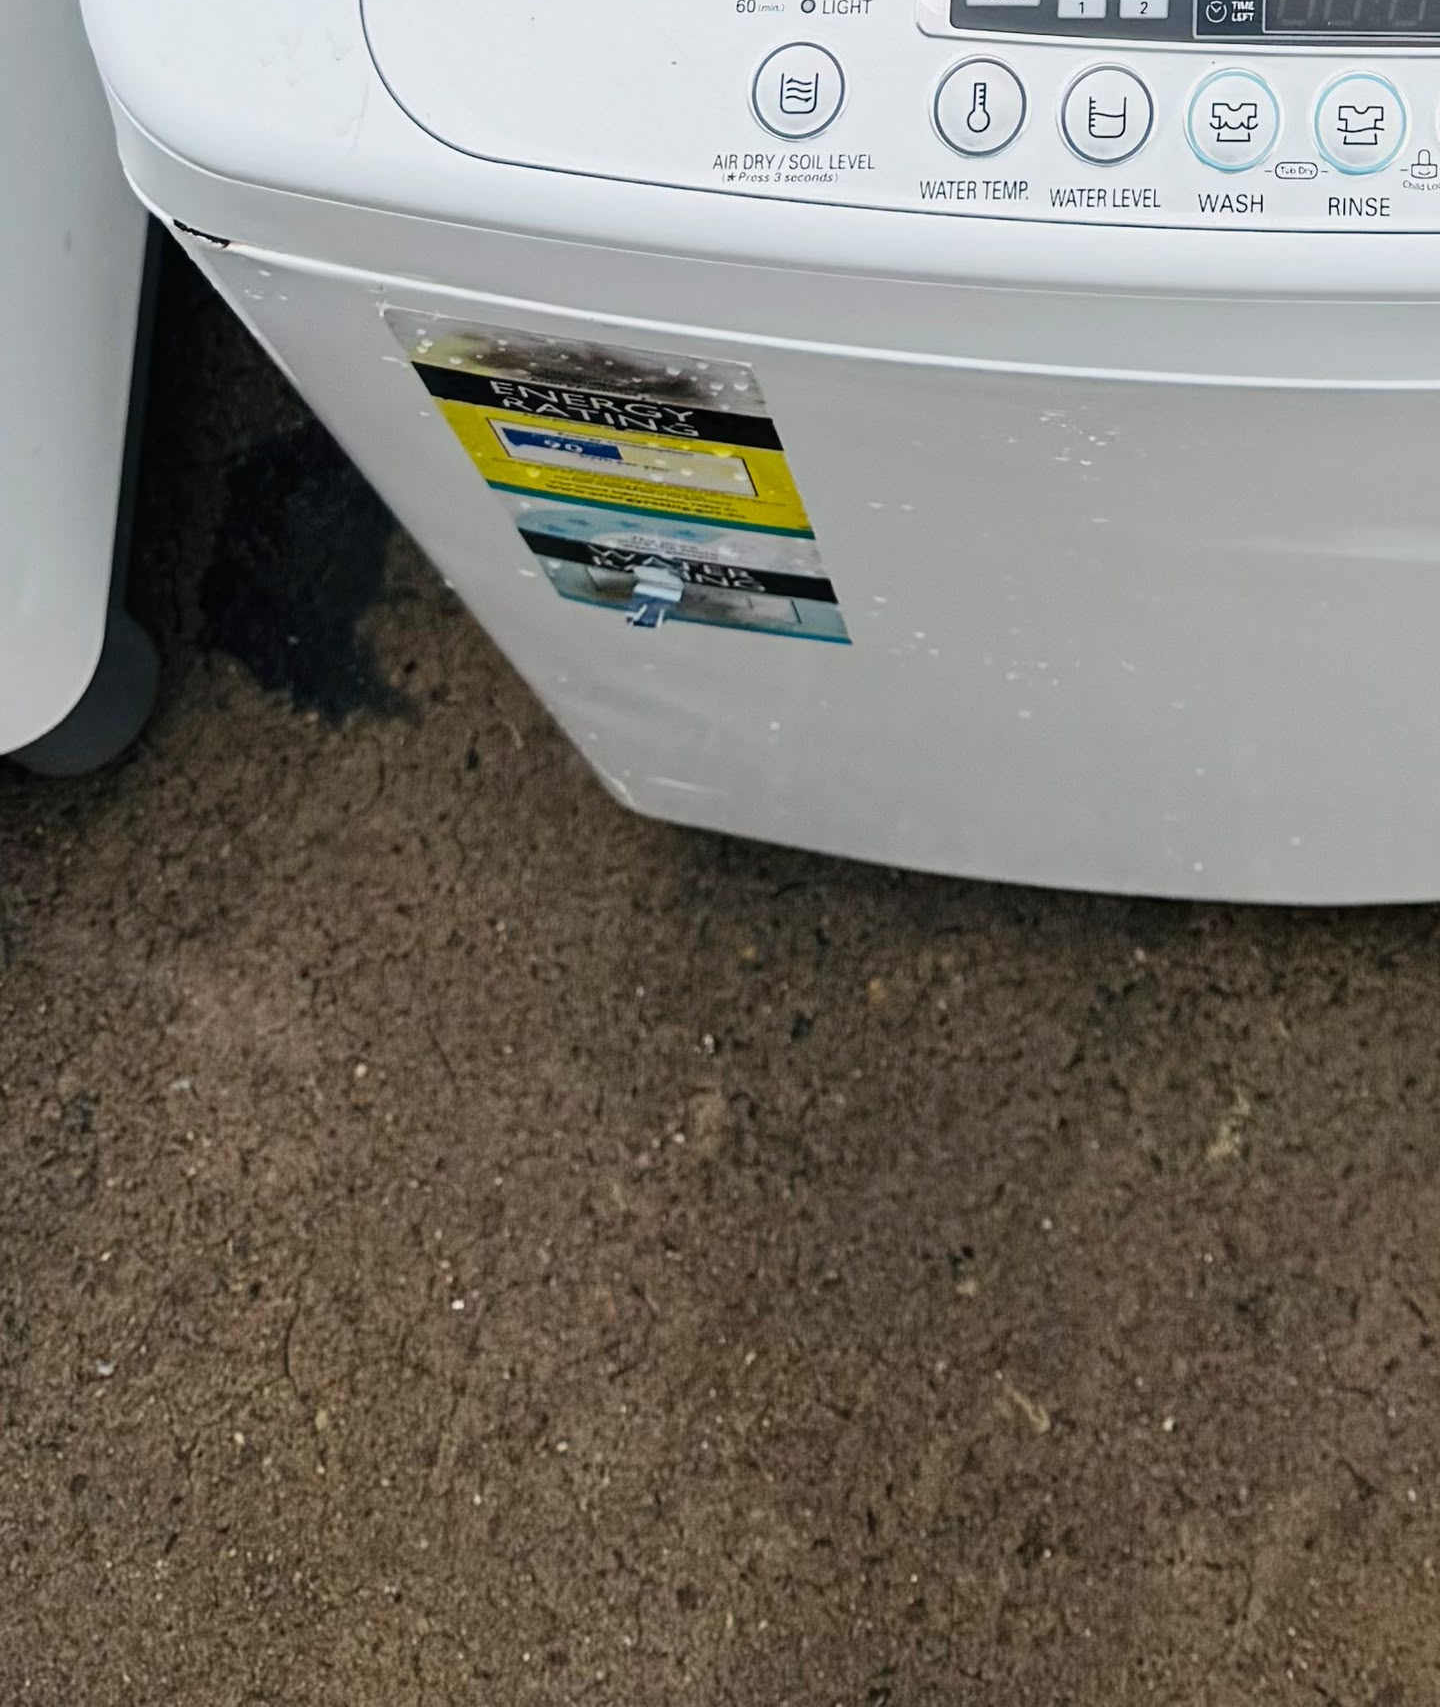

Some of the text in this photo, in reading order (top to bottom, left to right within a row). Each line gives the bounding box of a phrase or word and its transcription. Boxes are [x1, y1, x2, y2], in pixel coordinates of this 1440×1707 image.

[822, 0, 873, 15] LIGHT
[1079, 2, 1085, 15] 1
[1140, 1, 1149, 15] 2
[1231, 1, 1254, 11] TIME
[1231, 12, 1254, 22] LEFT
[712, 154, 738, 170] AIR
[743, 154, 775, 170] DRY
[788, 154, 823, 170] SOIL
[829, 154, 875, 170] LEVEL
[920, 180, 1030, 200] WATER TEMP.
[1050, 189, 1161, 208] WATER LEVEL
[1198, 194, 1264, 213] WASH
[1328, 197, 1391, 217] RINSE
[489, 380, 694, 423] ENERGY
[502, 397, 700, 436] RATING
